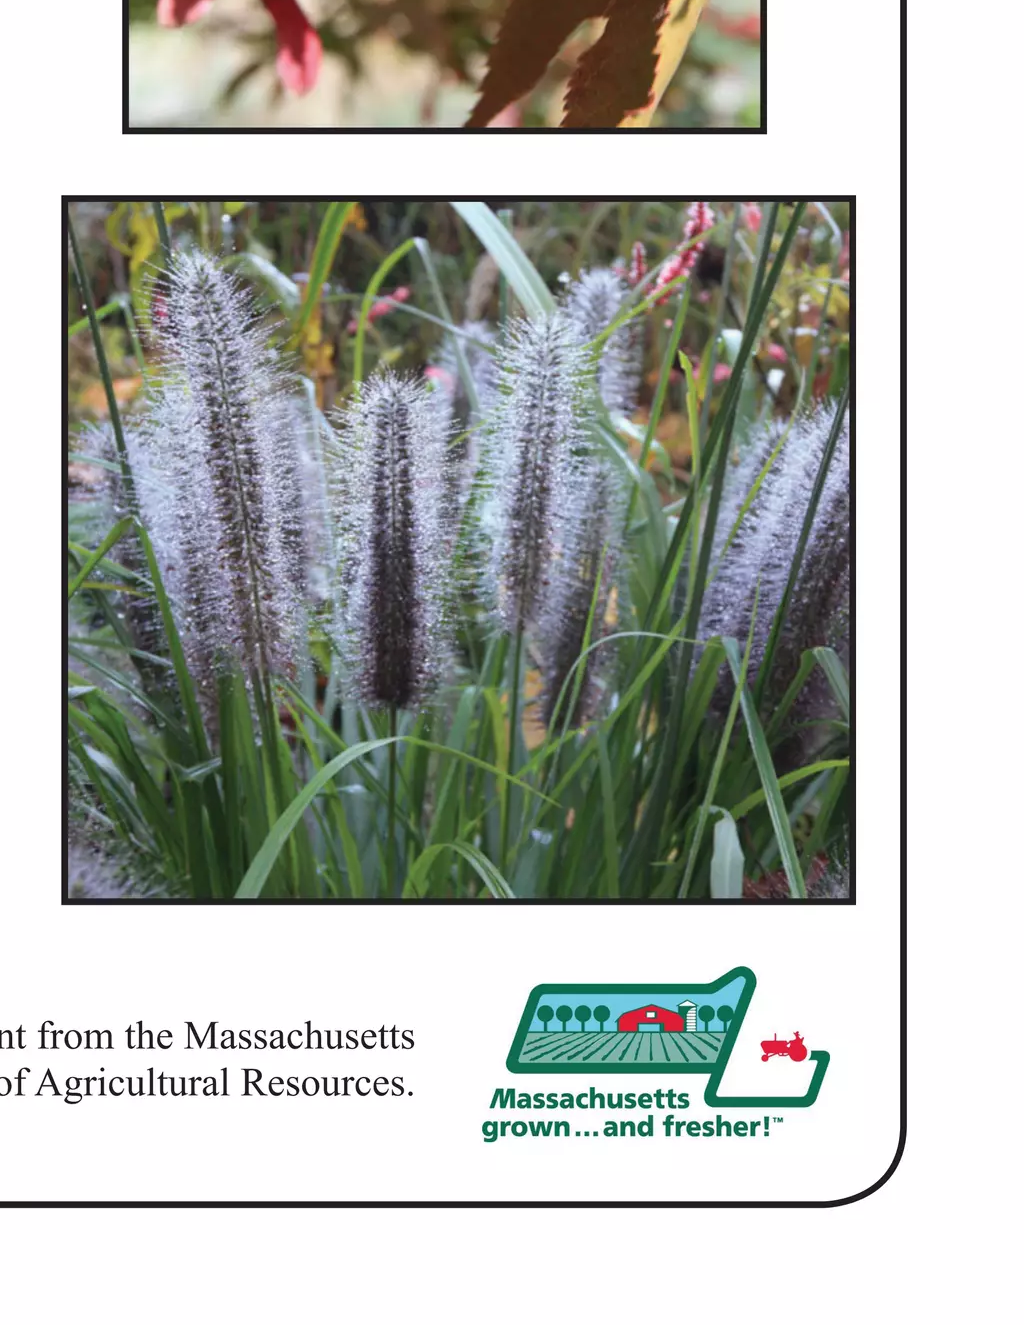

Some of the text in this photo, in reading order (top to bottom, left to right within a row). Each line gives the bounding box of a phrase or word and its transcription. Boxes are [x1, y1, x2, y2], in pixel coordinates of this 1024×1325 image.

[37, 1020, 115, 1050] from
[124, 1020, 173, 1050] the
[183, 1020, 415, 1050] Massachusetts
[34, 1066, 230, 1105] Agricultural
[240, 1068, 414, 1097] Resources.
[489, 1086, 690, 1110] Massachusetts
